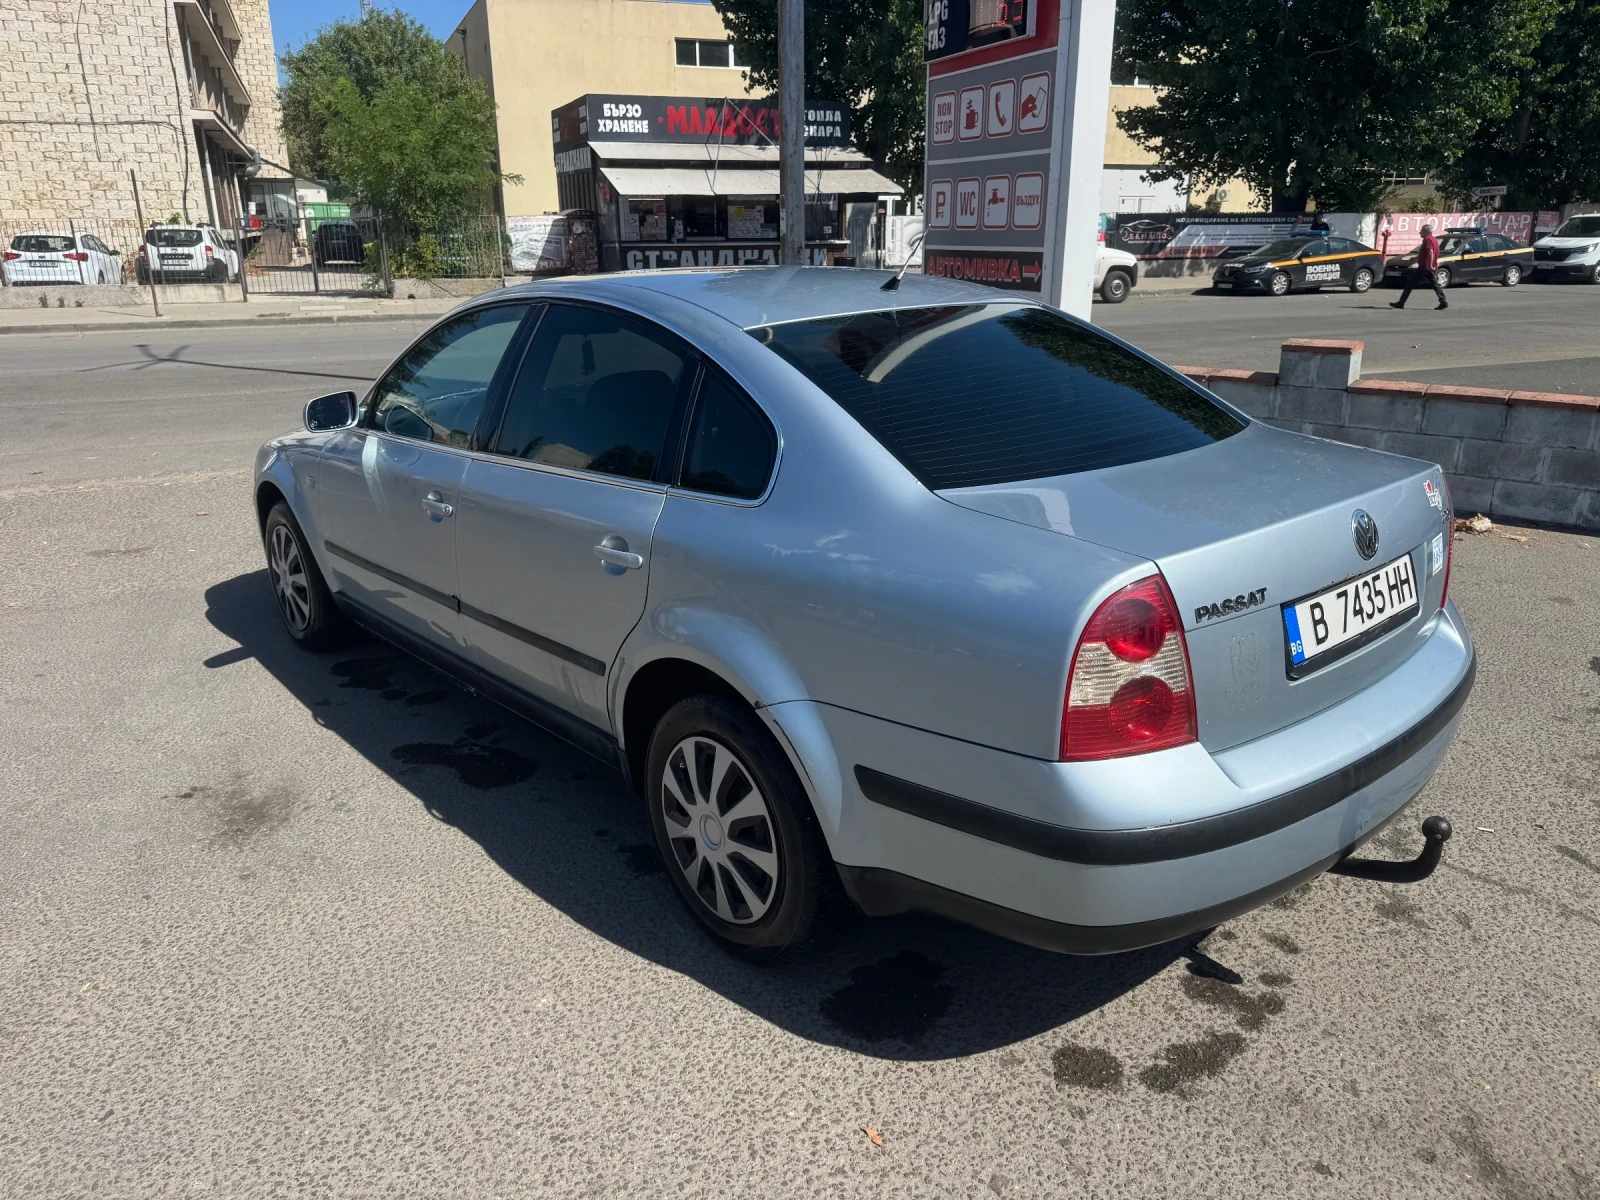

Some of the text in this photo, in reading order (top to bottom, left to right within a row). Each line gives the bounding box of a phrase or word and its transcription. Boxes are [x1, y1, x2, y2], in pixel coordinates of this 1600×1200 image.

[928, 0, 948, 24] LPG
[927, 27, 946, 51] ГАЗ
[603, 103, 642, 118] БЪРЗО
[937, 102, 952, 117] NON
[597, 119, 649, 133] ХРАНЕНЕ
[667, 105, 780, 137] МЛАДОСТ
[935, 120, 953, 135] STOP
[960, 191, 976, 216] WC
[1016, 195, 1040, 207] ВЪЗДУХ
[926, 256, 1022, 283] АВТОМИВКА
[1306, 263, 1341, 274] ВОЕННА
[1306, 272, 1341, 281] ПОЛИЦИЯ
[1195, 587, 1267, 624] PASSAT
[1310, 602, 1329, 645] B
[1291, 641, 1303, 655] BG
